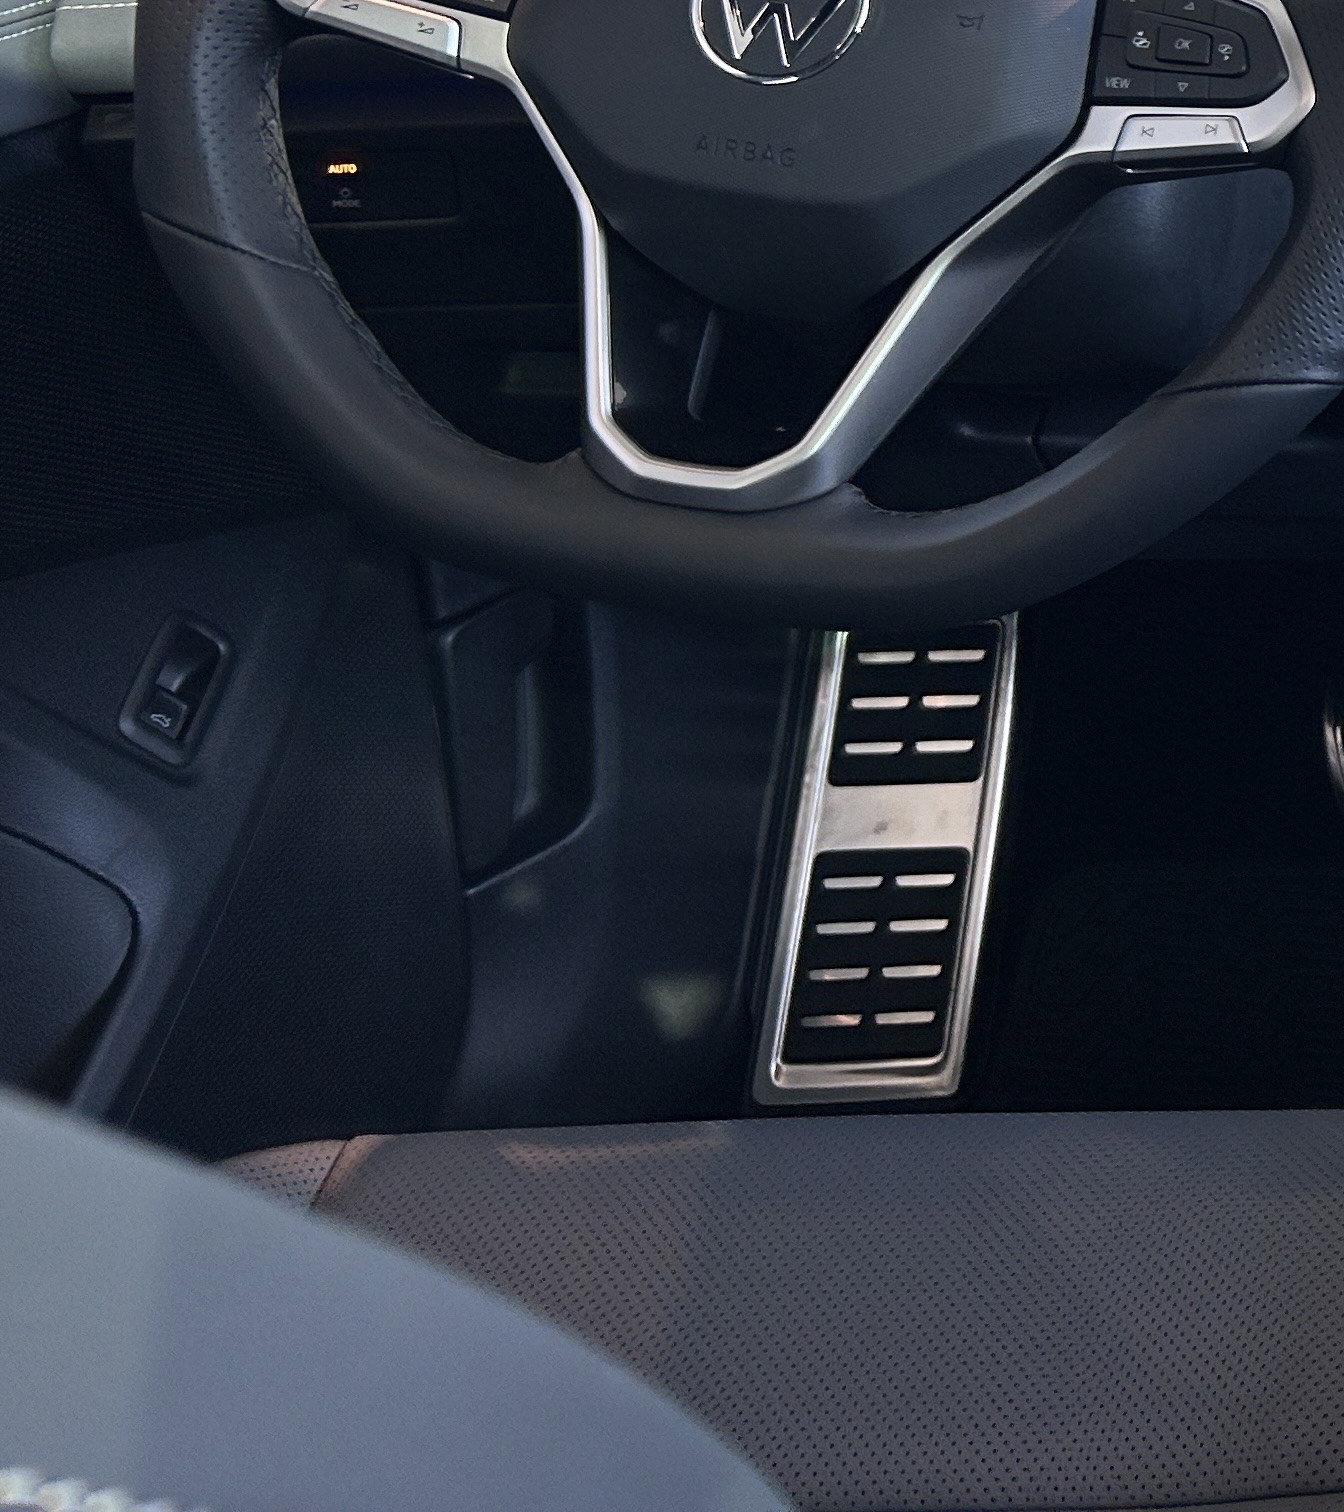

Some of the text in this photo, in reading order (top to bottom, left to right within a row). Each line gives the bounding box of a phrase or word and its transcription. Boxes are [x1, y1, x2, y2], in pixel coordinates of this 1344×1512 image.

[1105, 76, 1132, 89] VIEW
[696, 136, 797, 168] AIRBAG
[327, 163, 358, 174] AUTO
